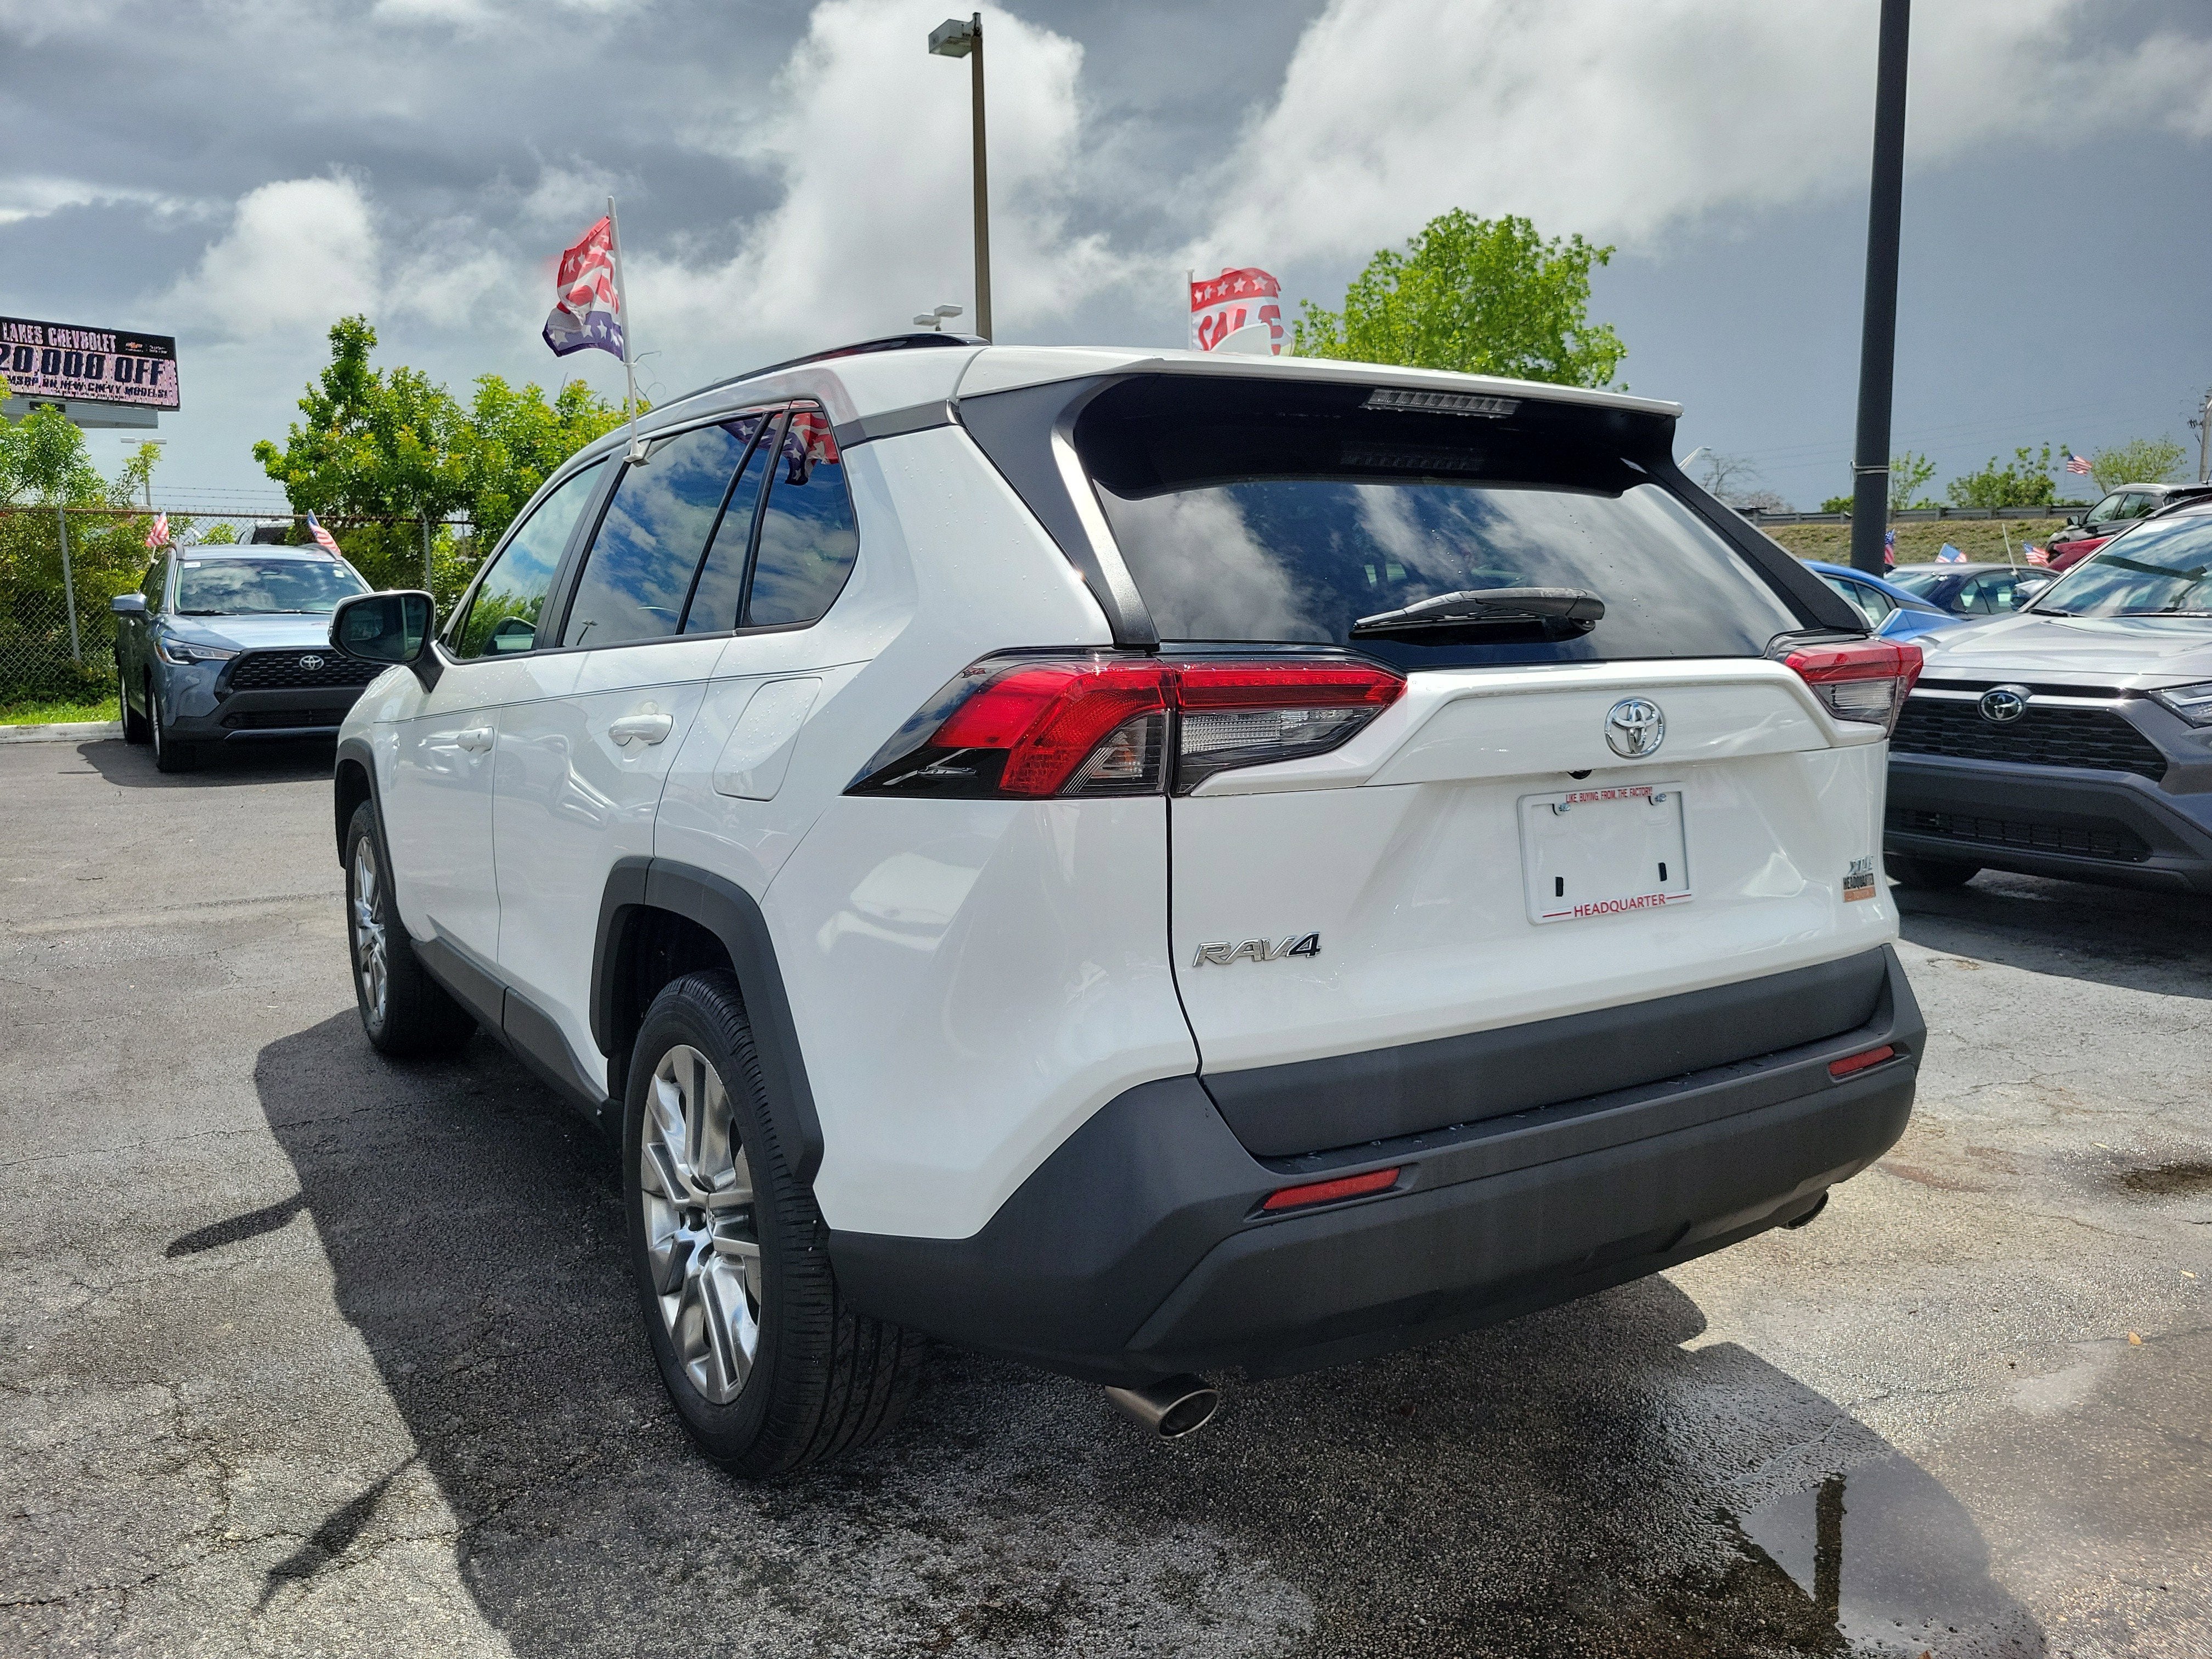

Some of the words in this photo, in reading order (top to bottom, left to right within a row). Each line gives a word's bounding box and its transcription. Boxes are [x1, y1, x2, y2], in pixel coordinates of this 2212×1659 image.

[2, 322, 43, 345] LAKES
[48, 327, 116, 353] CHEVROLET
[114, 357, 164, 385] OFF
[60, 380, 84, 391] NEW
[88, 383, 122, 394] CHEVY
[1566, 793, 1578, 803] LIKE
[1579, 791, 1599, 802] BUYING
[1601, 789, 1616, 799] FROM
[1618, 788, 1628, 798] THE
[1573, 893, 1666, 917] HEADQUARTER
[1192, 931, 1322, 967] RAV4
